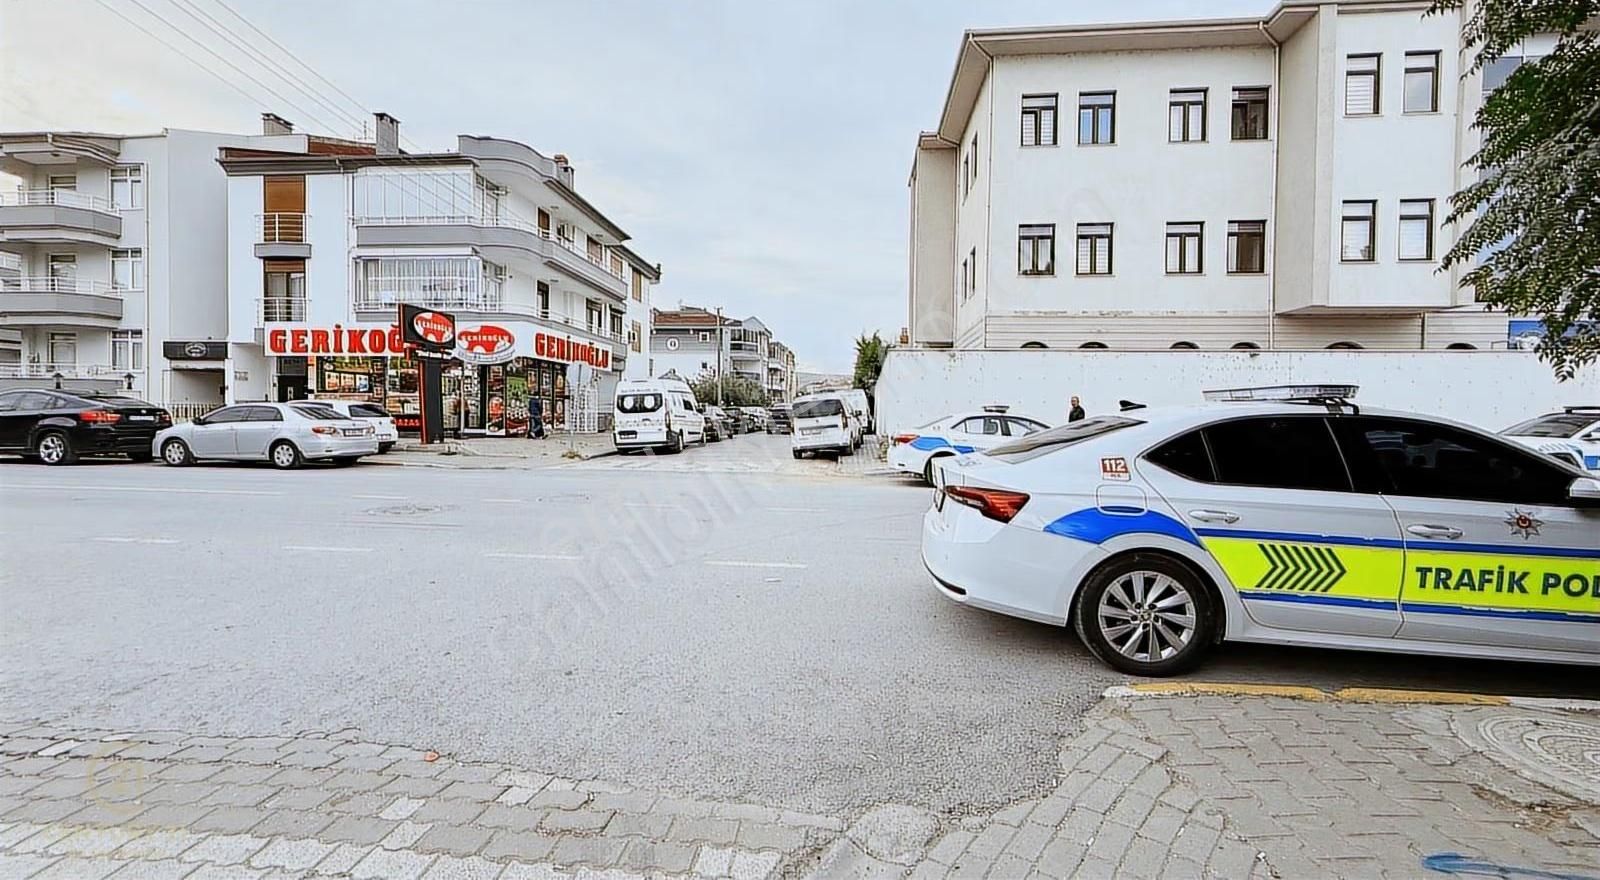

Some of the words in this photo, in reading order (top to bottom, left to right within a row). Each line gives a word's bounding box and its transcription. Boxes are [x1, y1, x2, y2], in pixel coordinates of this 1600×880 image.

[269, 323, 404, 354] GERİKOĞ
[535, 332, 609, 369] GERİKOĞLU
[1103, 459, 1126, 472] 112
[1415, 565, 1530, 595] TRAFİK
